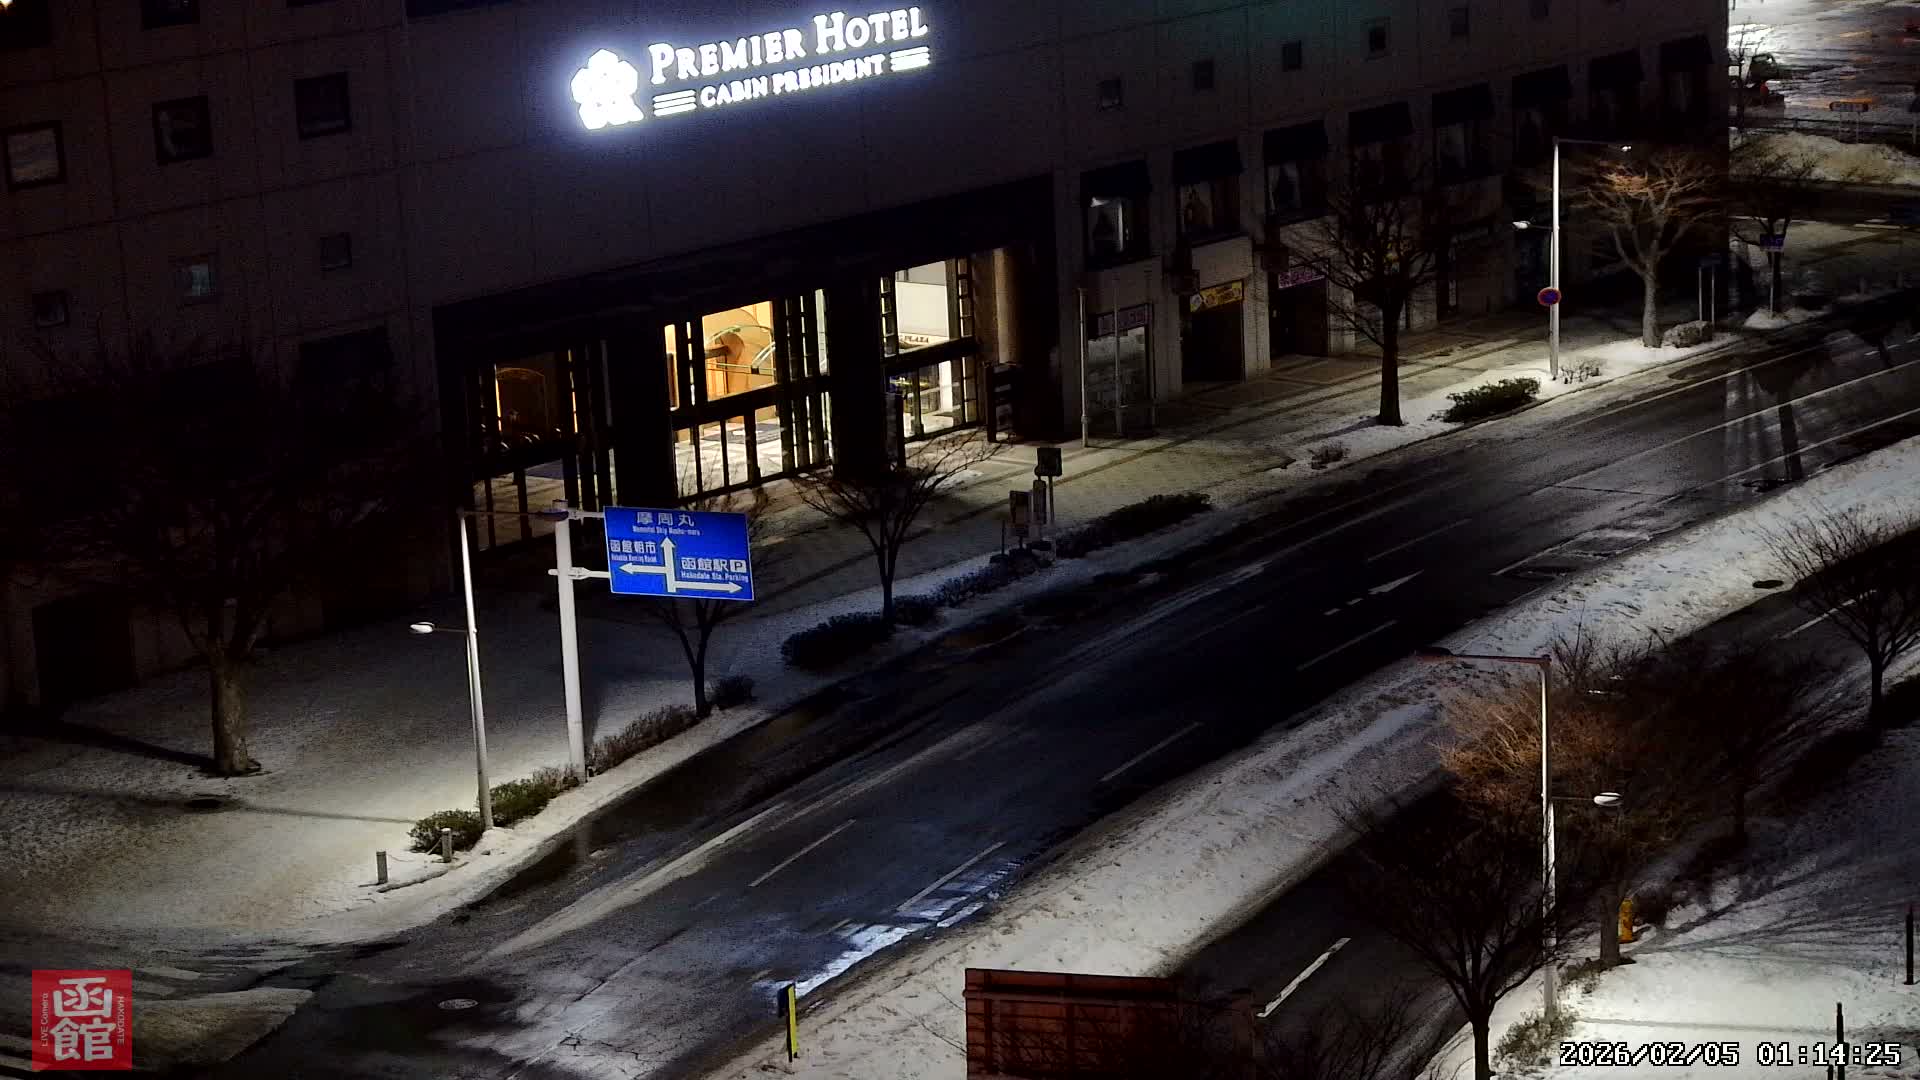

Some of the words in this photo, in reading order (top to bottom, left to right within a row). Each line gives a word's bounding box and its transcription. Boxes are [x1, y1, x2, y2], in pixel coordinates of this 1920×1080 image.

[648, 28, 807, 84] PREMIER
[812, 6, 929, 55] HOTEL
[700, 75, 769, 108] CABIN
[772, 53, 886, 95] PRESIDENT
[637, 511, 695, 527] 摩周丸
[725, 574, 749, 582] Parking
